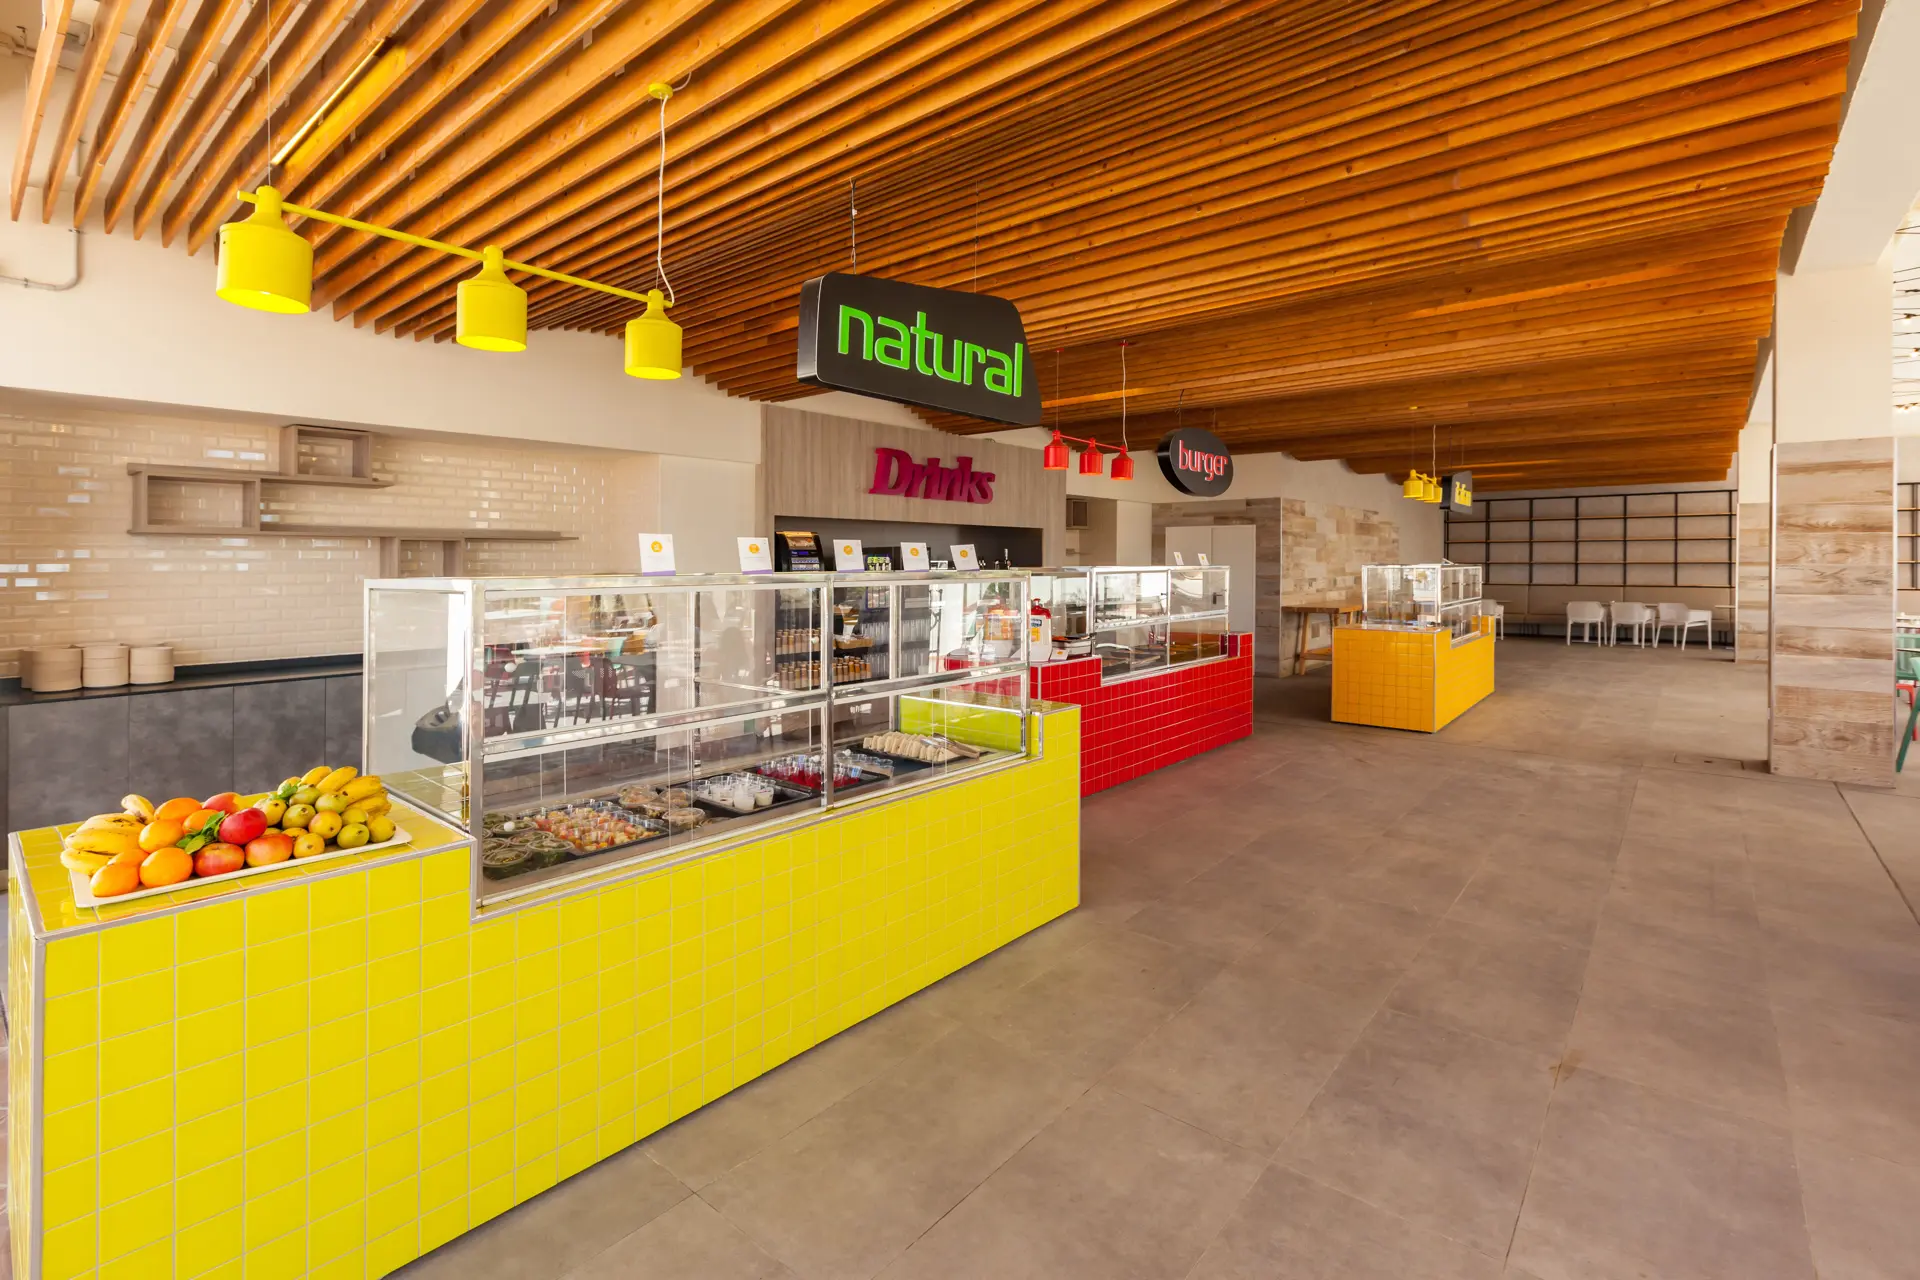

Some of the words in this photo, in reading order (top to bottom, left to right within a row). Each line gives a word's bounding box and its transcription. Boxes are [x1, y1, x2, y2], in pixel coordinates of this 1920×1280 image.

[838, 304, 1023, 398] natural
[868, 447, 996, 505] Drinks
[1178, 439, 1229, 482] burger
